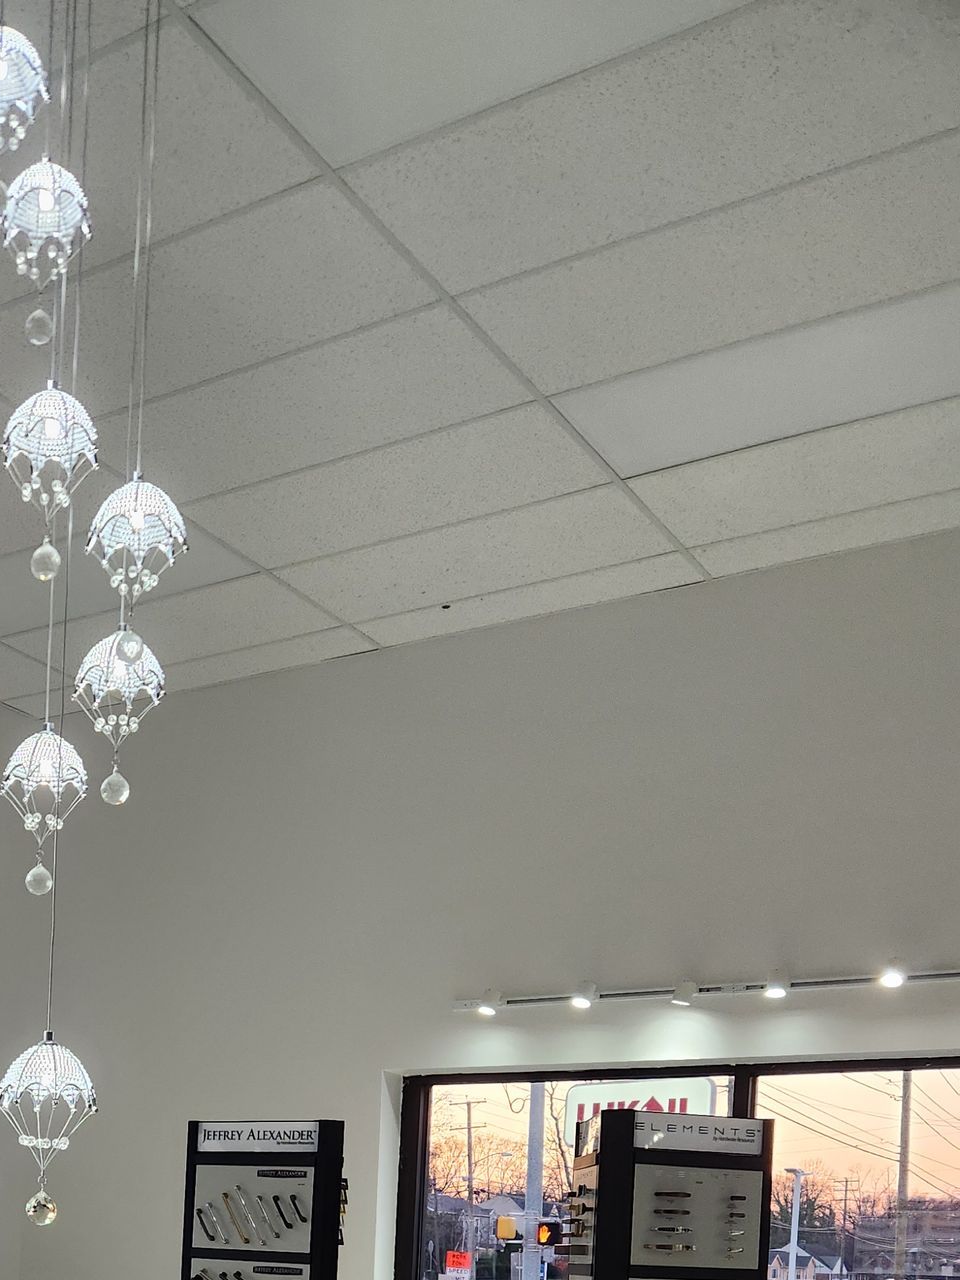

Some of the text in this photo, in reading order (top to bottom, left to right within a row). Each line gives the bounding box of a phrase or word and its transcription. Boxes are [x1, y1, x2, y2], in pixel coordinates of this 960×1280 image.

[202, 1129, 315, 1143] JEFFREY ALEXANDER
[635, 1121, 757, 1138] ELEMENTS
